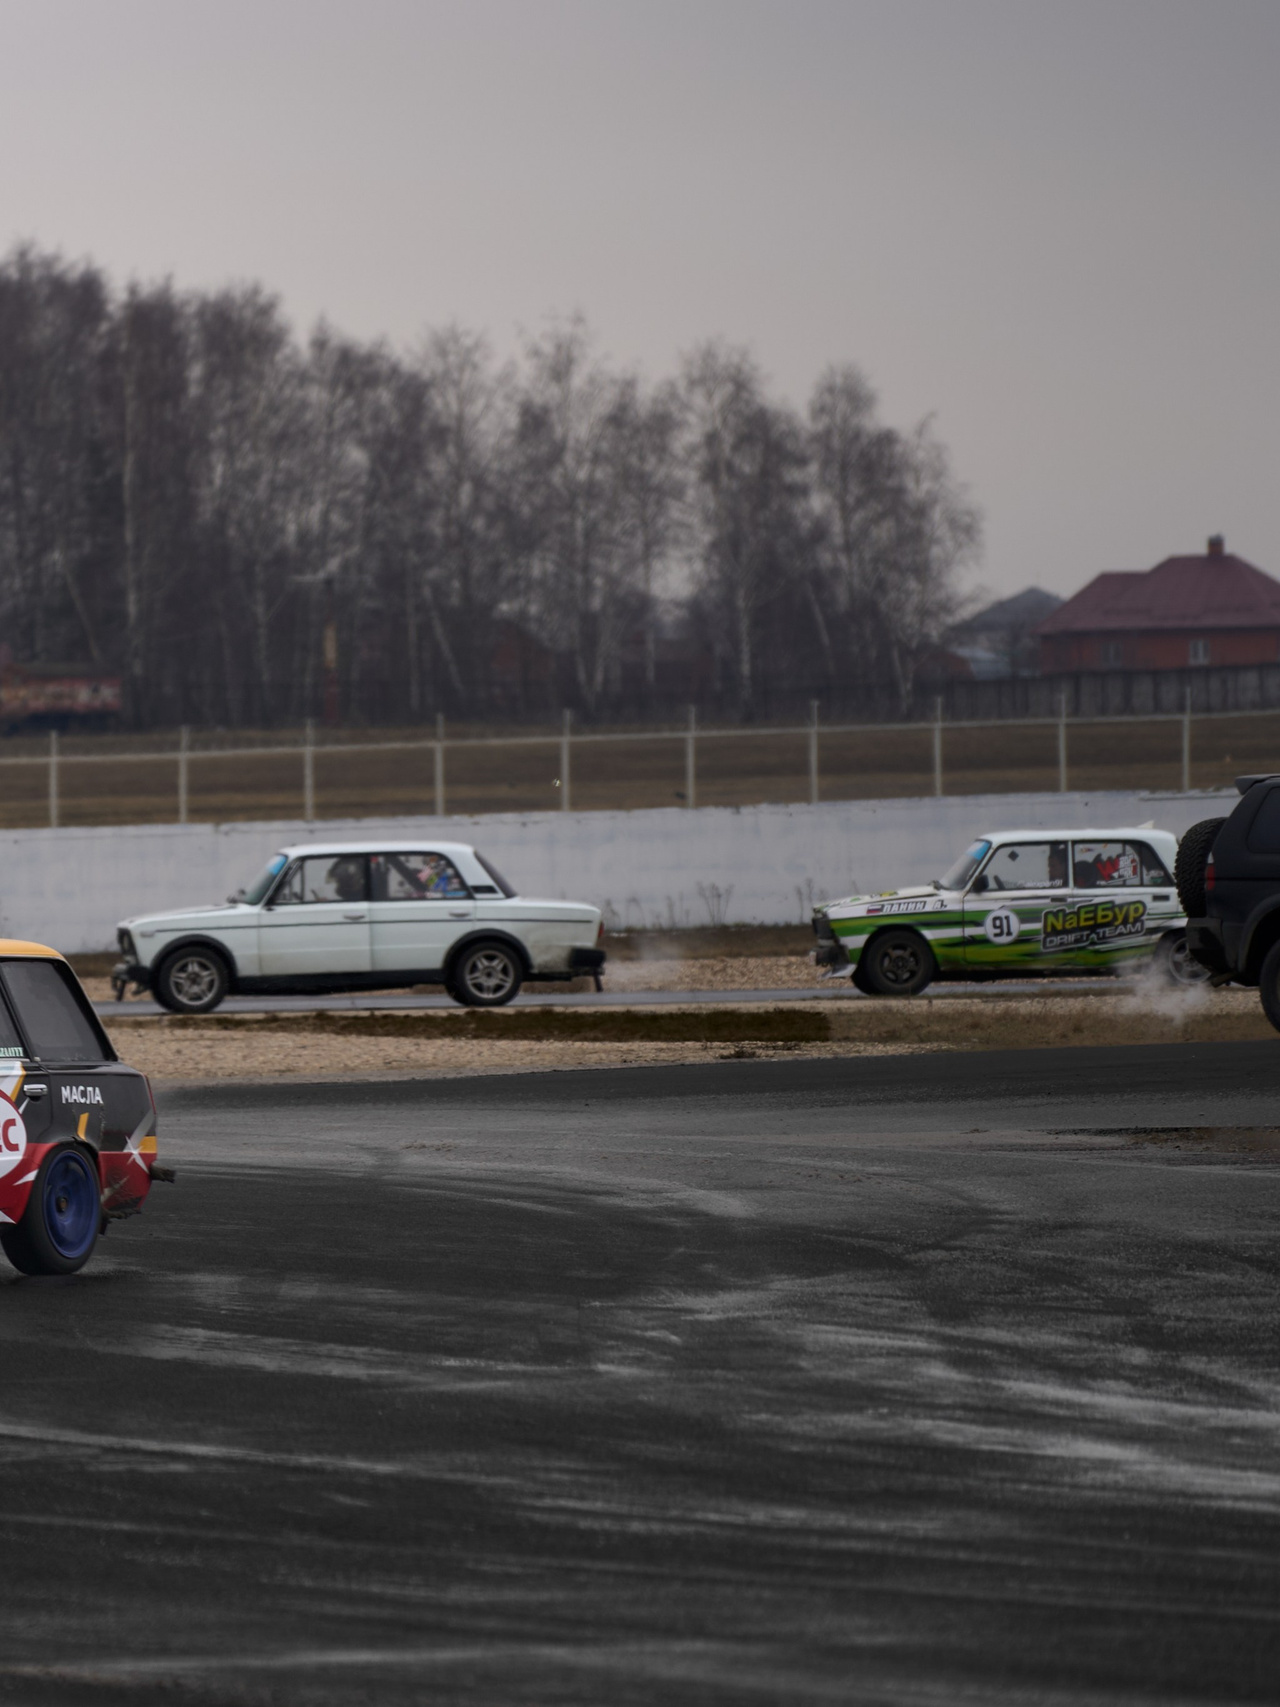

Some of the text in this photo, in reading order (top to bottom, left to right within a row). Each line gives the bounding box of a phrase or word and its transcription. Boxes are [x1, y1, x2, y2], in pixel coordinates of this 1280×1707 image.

[883, 901, 926, 913] ПАНИН
[991, 915, 1013, 938] 91
[1045, 922, 1143, 947] DRIFT TEAM
[61, 1085, 104, 1104] МАСЛА
